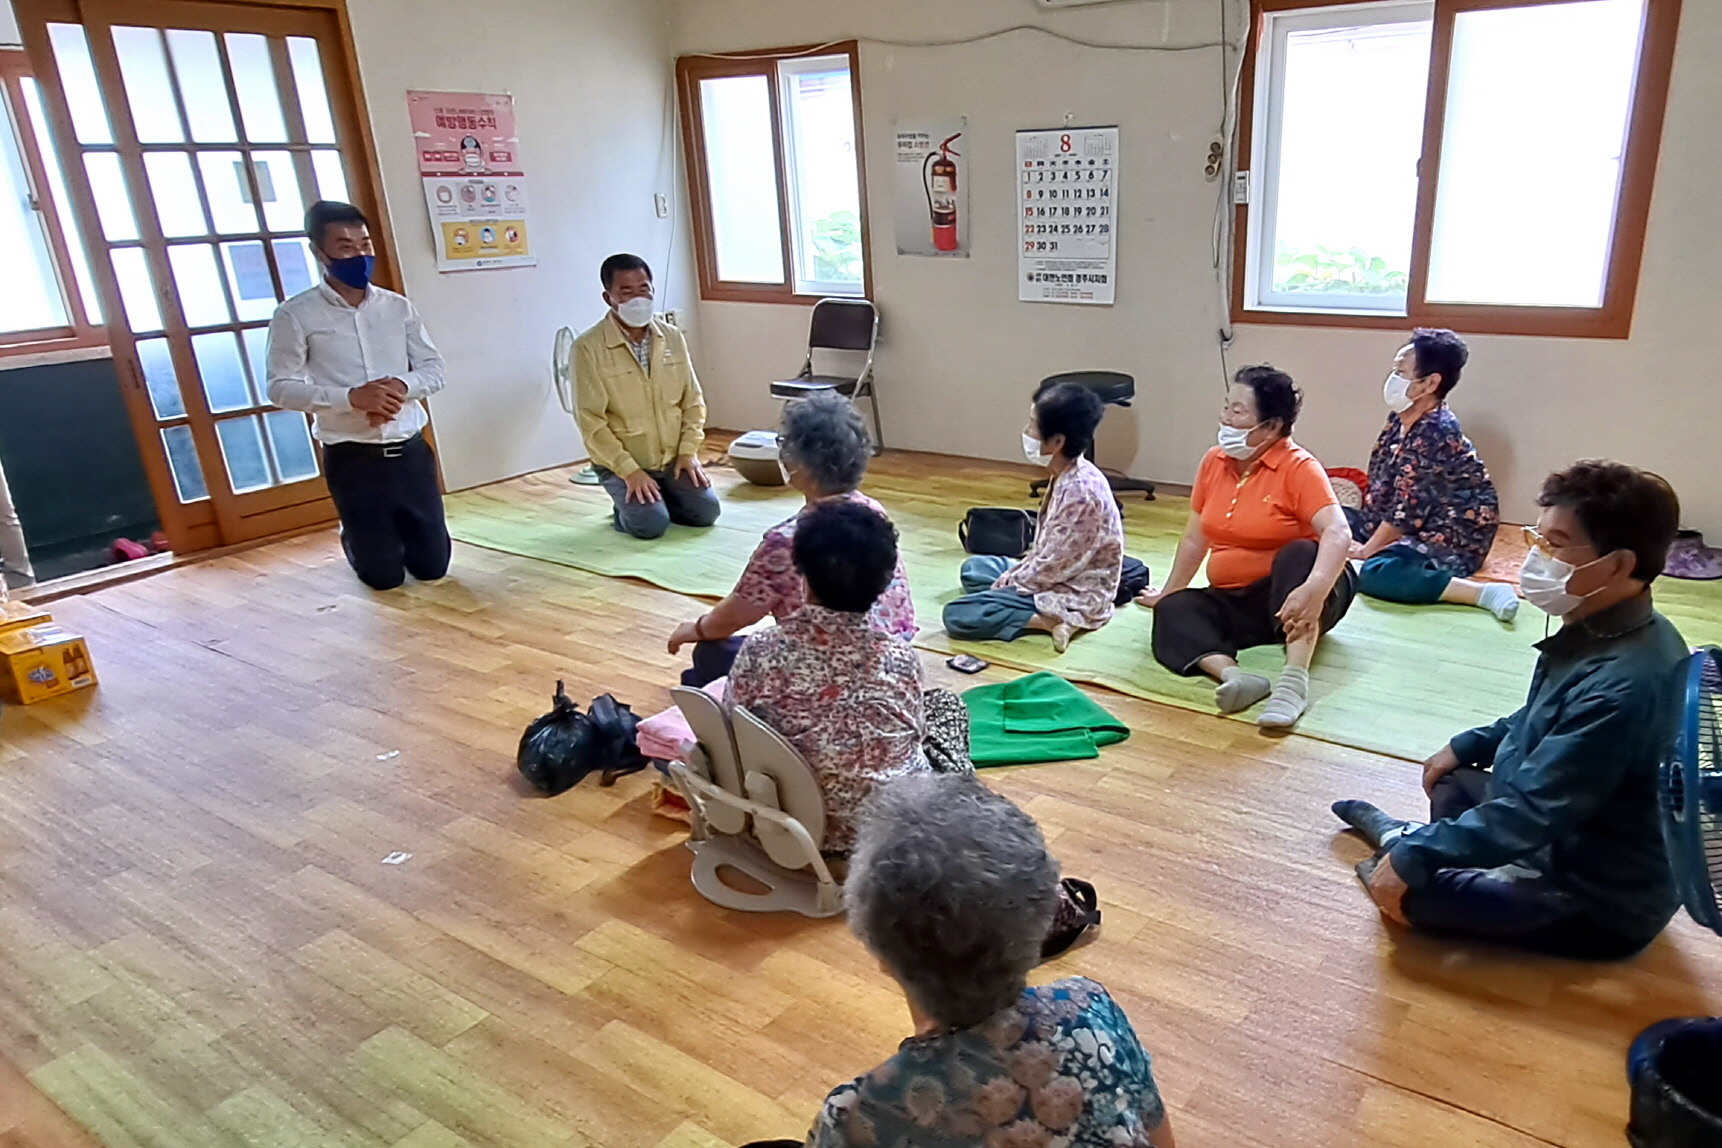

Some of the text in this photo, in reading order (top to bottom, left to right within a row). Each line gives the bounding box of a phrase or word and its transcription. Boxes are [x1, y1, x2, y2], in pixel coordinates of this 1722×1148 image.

[436, 115, 497, 130] 예방행동수칙
[1060, 134, 1071, 152] 8
[1038, 172, 1043, 181] 2
[1051, 171, 1056, 181] 3
[1062, 171, 1068, 180] 4
[1075, 171, 1081, 180] 5
[1088, 170, 1094, 180] 6
[1102, 170, 1108, 180] 7
[1038, 190, 1043, 199] 9
[1049, 190, 1057, 198] 10
[1062, 189, 1069, 198] 11
[1074, 189, 1082, 198] 12
[1087, 189, 1095, 198] 13
[1100, 188, 1109, 197] 14
[1025, 206, 1108, 216] 15 16 17 18 19 20 21
[1025, 224, 1109, 234] 22 23 24 25 26 27 28
[1025, 242, 1058, 251] 29 30 31
